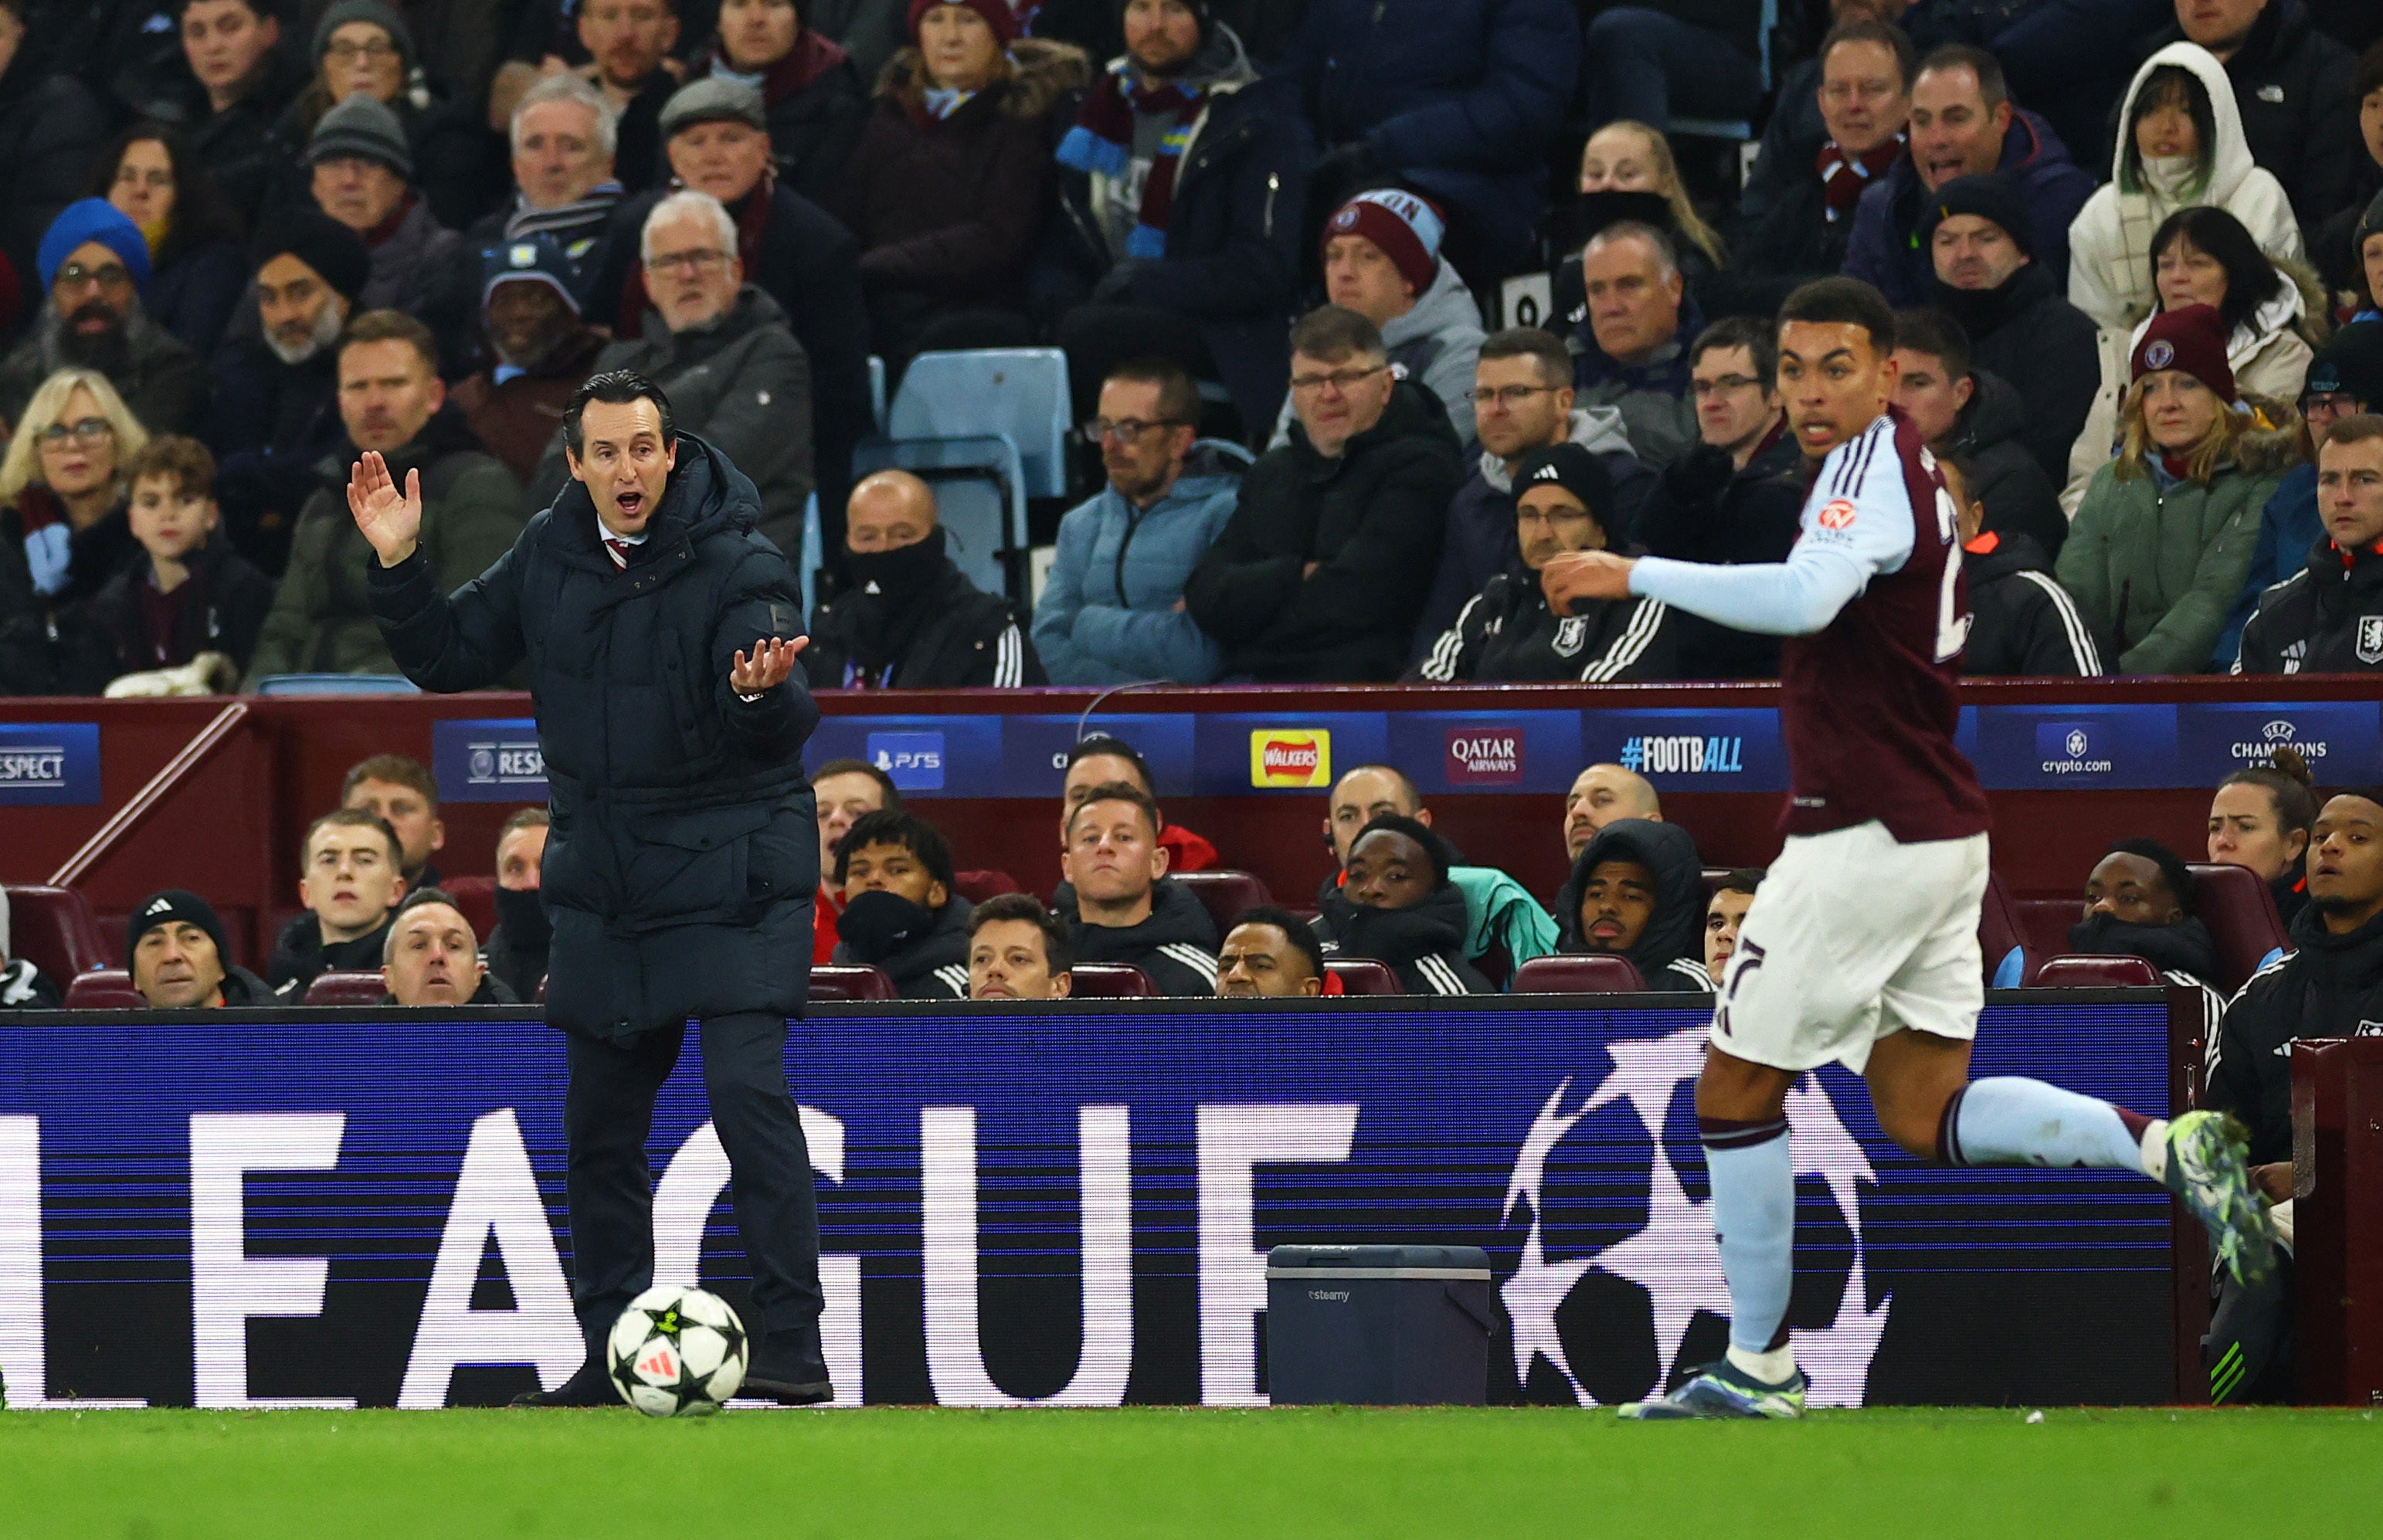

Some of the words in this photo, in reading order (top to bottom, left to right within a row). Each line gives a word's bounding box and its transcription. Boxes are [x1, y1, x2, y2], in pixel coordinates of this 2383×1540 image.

[2263, 724, 2293, 739] UEFA
[1264, 748, 1319, 767] WALKERS
[1452, 738, 1516, 764] QATAR
[1620, 736, 1743, 773] #FOOTBALL
[894, 752, 941, 769] PS5
[1467, 759, 1517, 772] AIRWAYS
[2042, 759, 2112, 775] crypto.com
